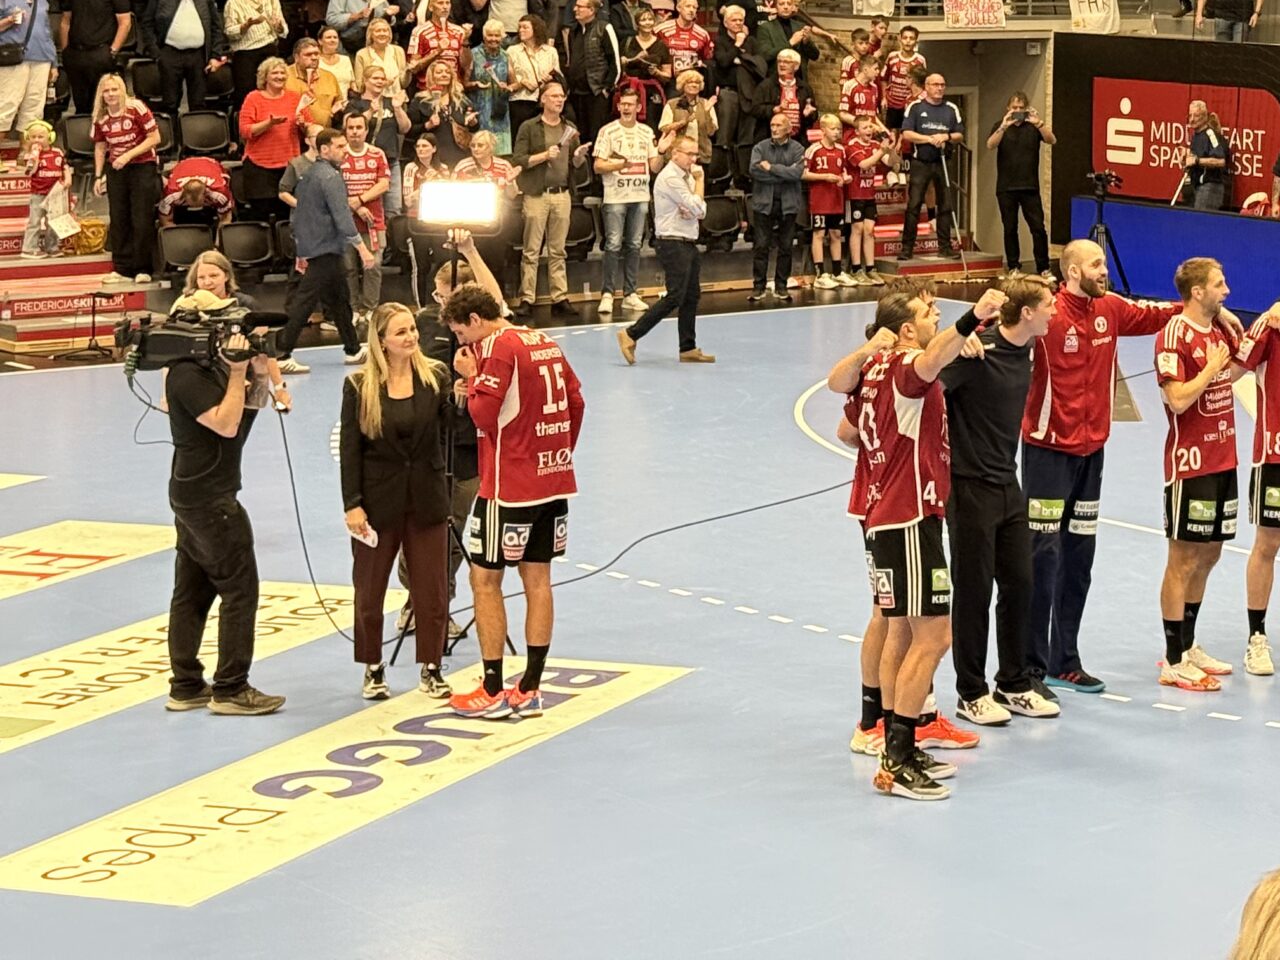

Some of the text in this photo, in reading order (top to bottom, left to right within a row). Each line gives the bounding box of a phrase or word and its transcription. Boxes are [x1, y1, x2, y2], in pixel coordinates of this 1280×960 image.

[816, 157, 828, 169] 31
[814, 215, 826, 228] 31
[539, 363, 568, 415] 15
[1177, 446, 1201, 471] 20
[252, 663, 631, 800] BUGG
[40, 803, 288, 885] Pipes
